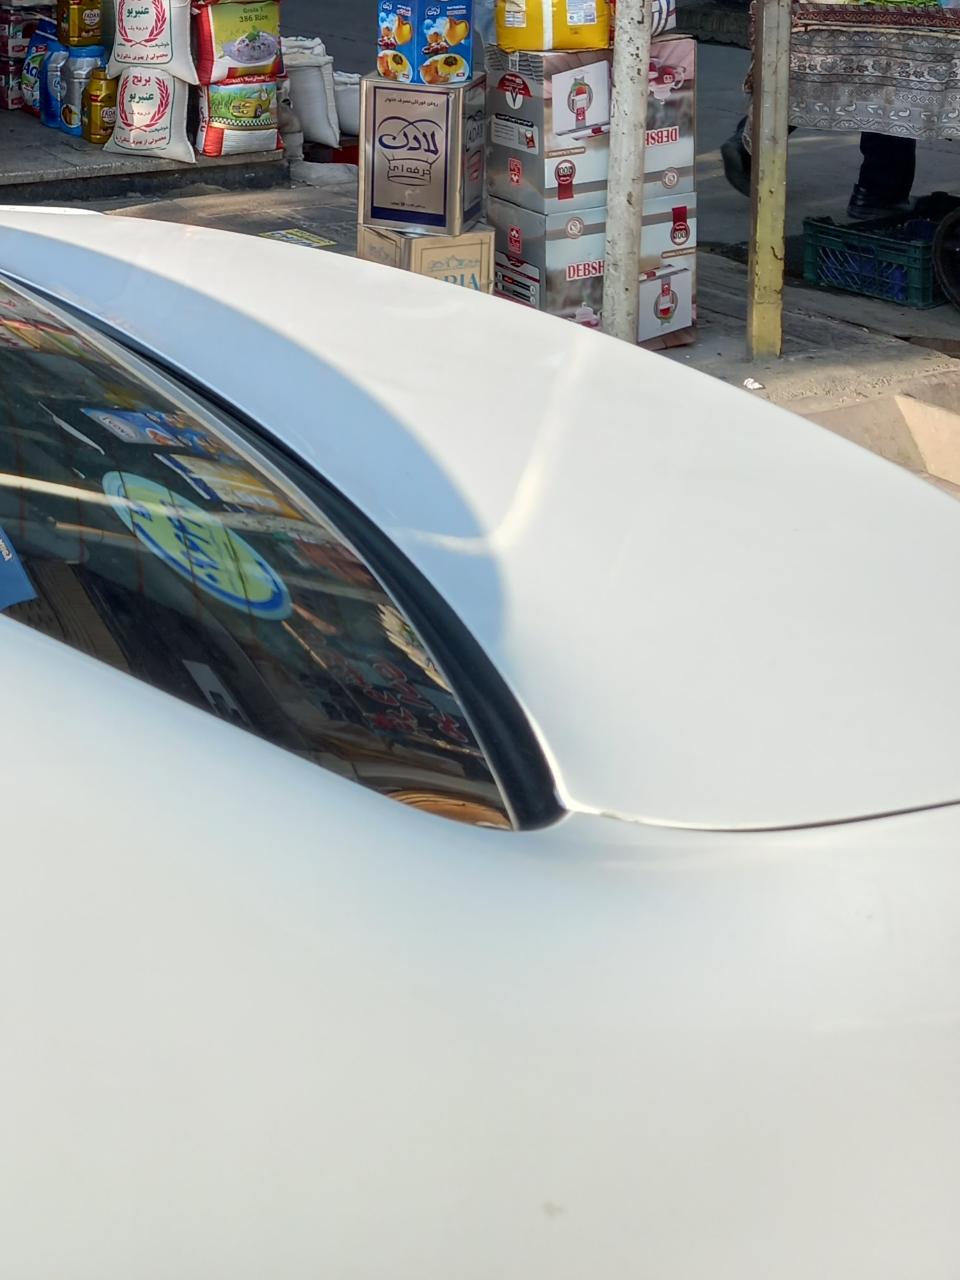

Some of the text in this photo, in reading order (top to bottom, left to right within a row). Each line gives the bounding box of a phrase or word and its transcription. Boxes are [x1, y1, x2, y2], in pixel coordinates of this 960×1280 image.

[126, 6, 150, 18] عنبربو
[131, 74, 152, 87] برنج
[128, 92, 154, 104] عنبربو
